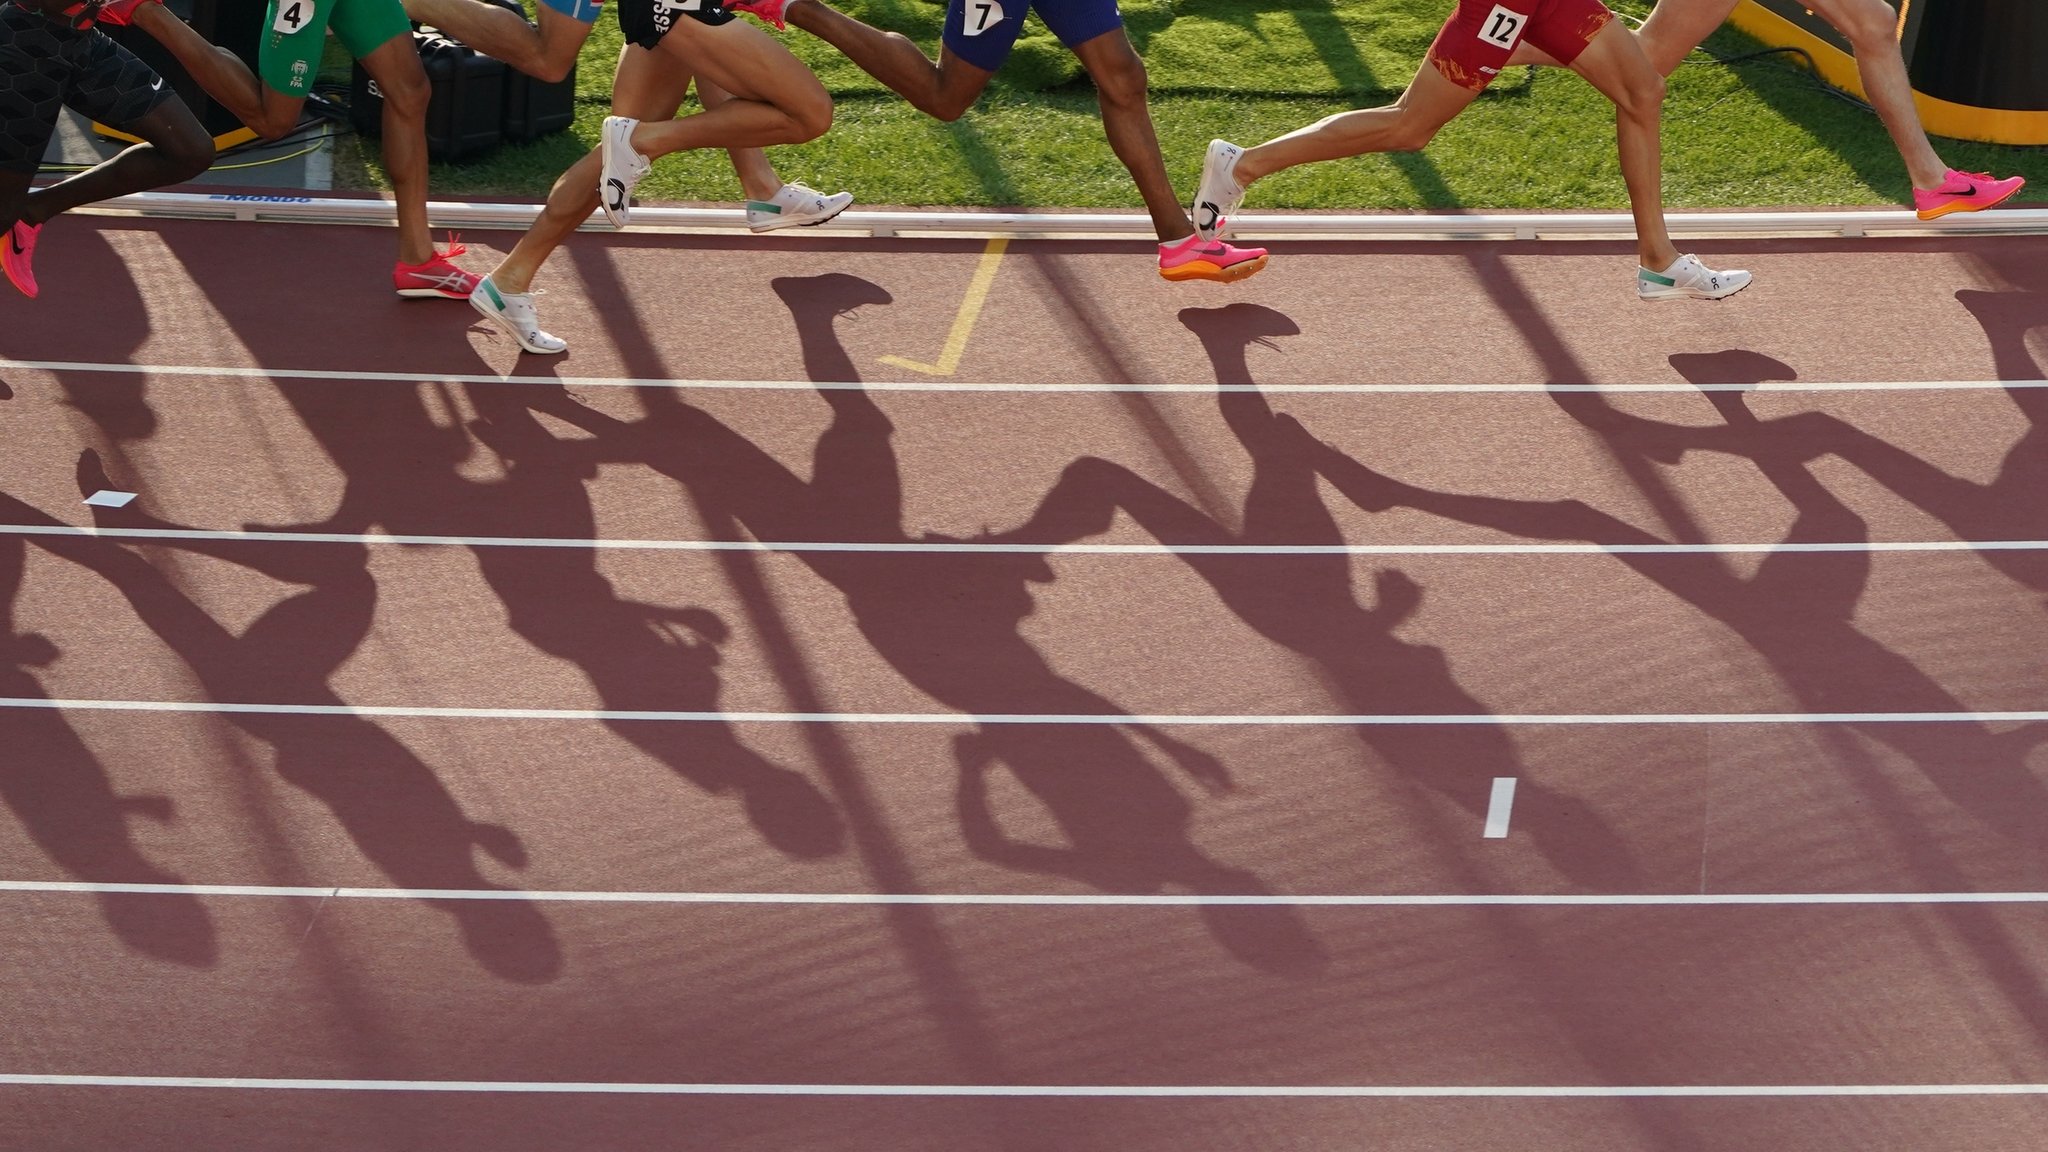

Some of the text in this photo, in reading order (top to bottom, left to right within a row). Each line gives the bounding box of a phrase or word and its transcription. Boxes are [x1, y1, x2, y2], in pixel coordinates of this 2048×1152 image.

[283, 2, 301, 29] 4
[975, 3, 992, 30] 7
[1489, 13, 1518, 43] 12
[225, 194, 312, 203] MONDO
